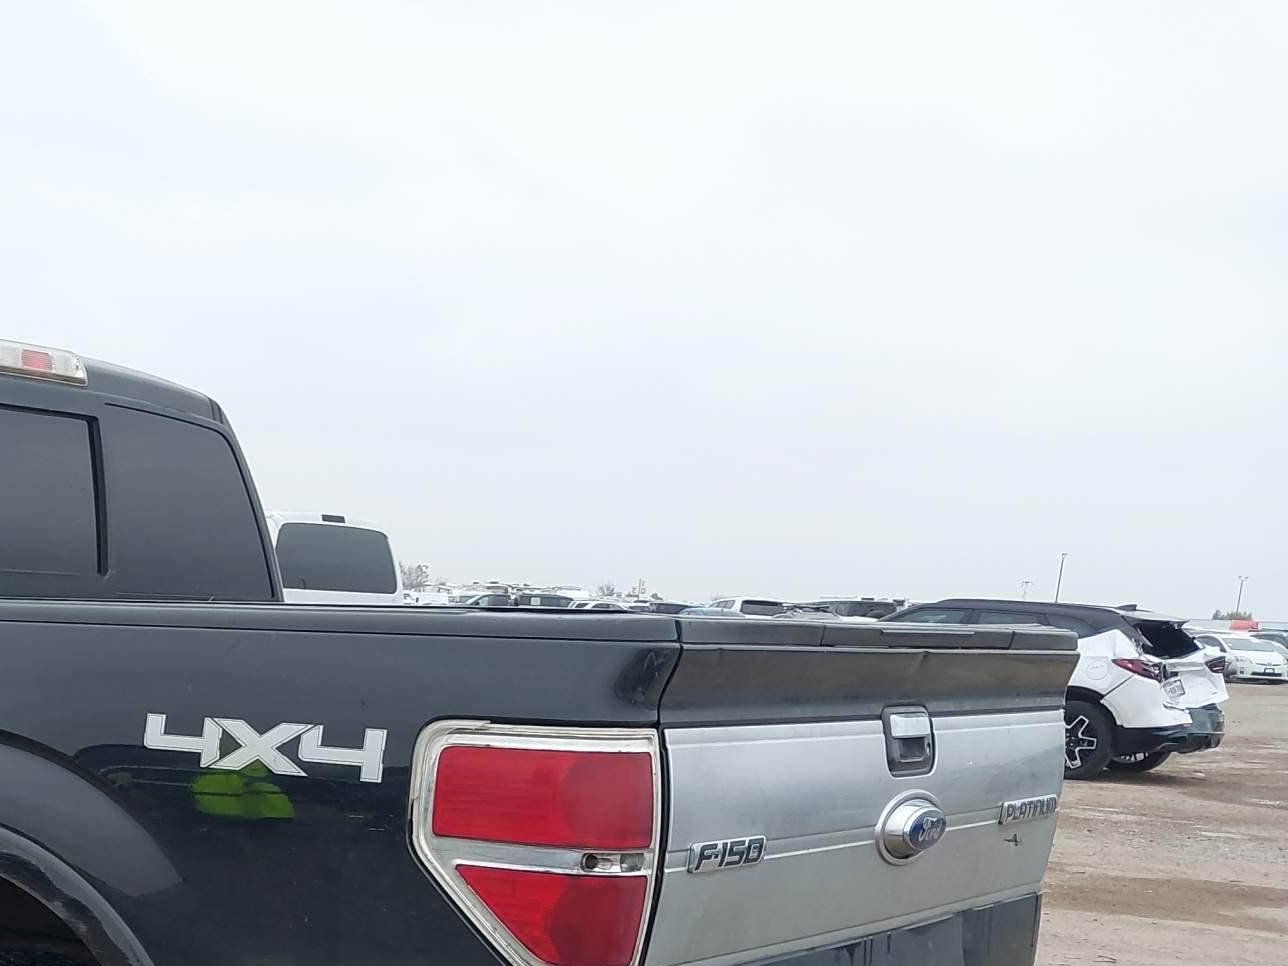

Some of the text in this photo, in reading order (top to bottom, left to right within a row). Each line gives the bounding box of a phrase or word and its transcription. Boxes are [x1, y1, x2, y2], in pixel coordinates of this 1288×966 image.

[1005, 796, 1057, 819] PLATINUM
[913, 813, 945, 842] Ford
[694, 837, 764, 871] F-150
